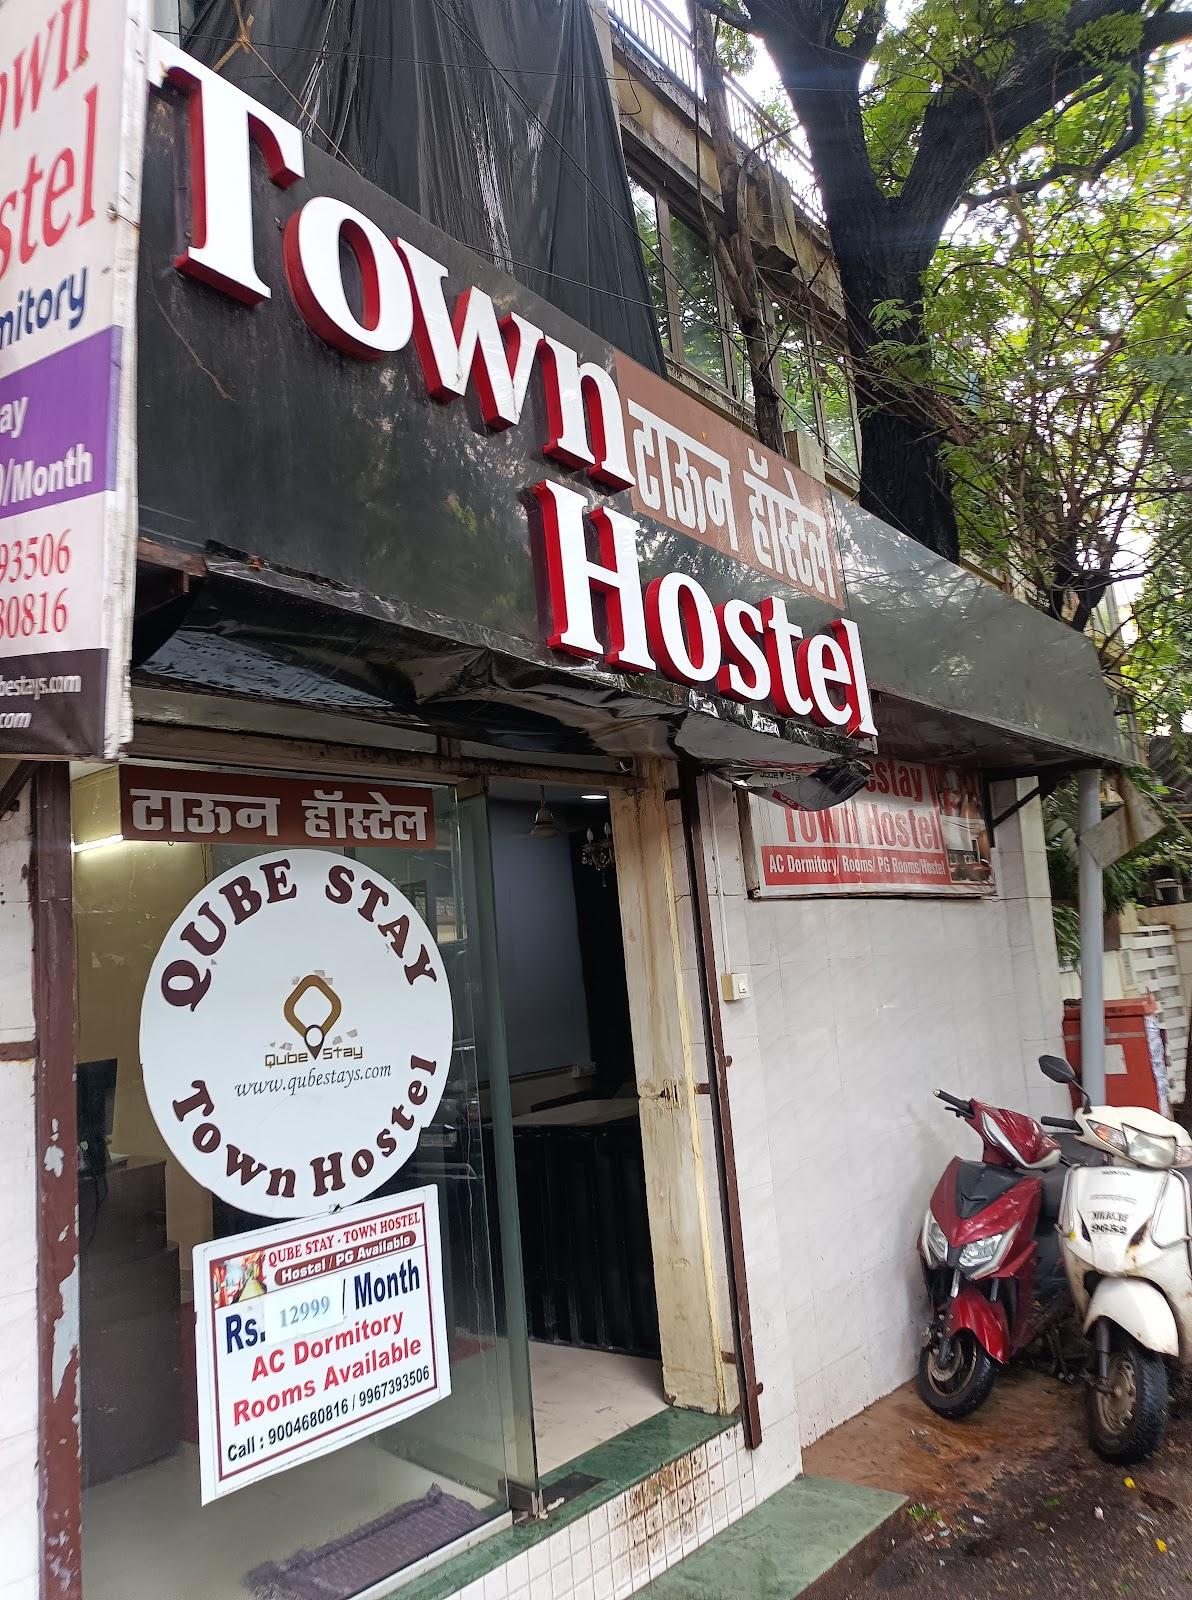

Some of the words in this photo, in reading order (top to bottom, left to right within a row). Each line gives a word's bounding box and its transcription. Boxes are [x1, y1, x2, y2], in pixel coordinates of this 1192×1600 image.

[146, 31, 634, 492] Town
[628, 398, 739, 552] टाऊन
[532, 479, 879, 738] Hostel
[130, 788, 280, 836] टाऊन
[301, 790, 428, 842] हॉस्टेल
[866, 803, 942, 850] Hostel
[769, 855, 785, 873] AC
[878, 857, 891, 873] PG
[161, 858, 298, 1012] QUBE
[325, 864, 438, 987] STAY
[234, 1062, 393, 1099] www.qubestays.com
[264, 1051, 308, 1068] Qube
[322, 1044, 364, 1062] Stay
[172, 1079, 297, 1198] Town
[311, 1054, 438, 1198] Hostel
[268, 1248, 302, 1267] QUBE
[305, 1234, 335, 1256] STAY
[344, 1225, 377, 1245] TOWN
[380, 1210, 421, 1233] HOSTEL
[281, 1258, 326, 1283] Hostel
[335, 1250, 356, 1268] PG
[357, 1234, 411, 1260] Available
[226, 1313, 266, 1354] Rs.
[279, 1295, 331, 1328] 12999
[354, 1259, 421, 1310] Month
[251, 1349, 286, 1382] AC
[294, 1311, 404, 1366] Dormitory
[228, 1437, 256, 1462] Call
[268, 1403, 349, 1445] 9004680816
[359, 1365, 430, 1408] 9967393506
[233, 1377, 316, 1426] Rooms
[323, 1337, 422, 1390] Available
